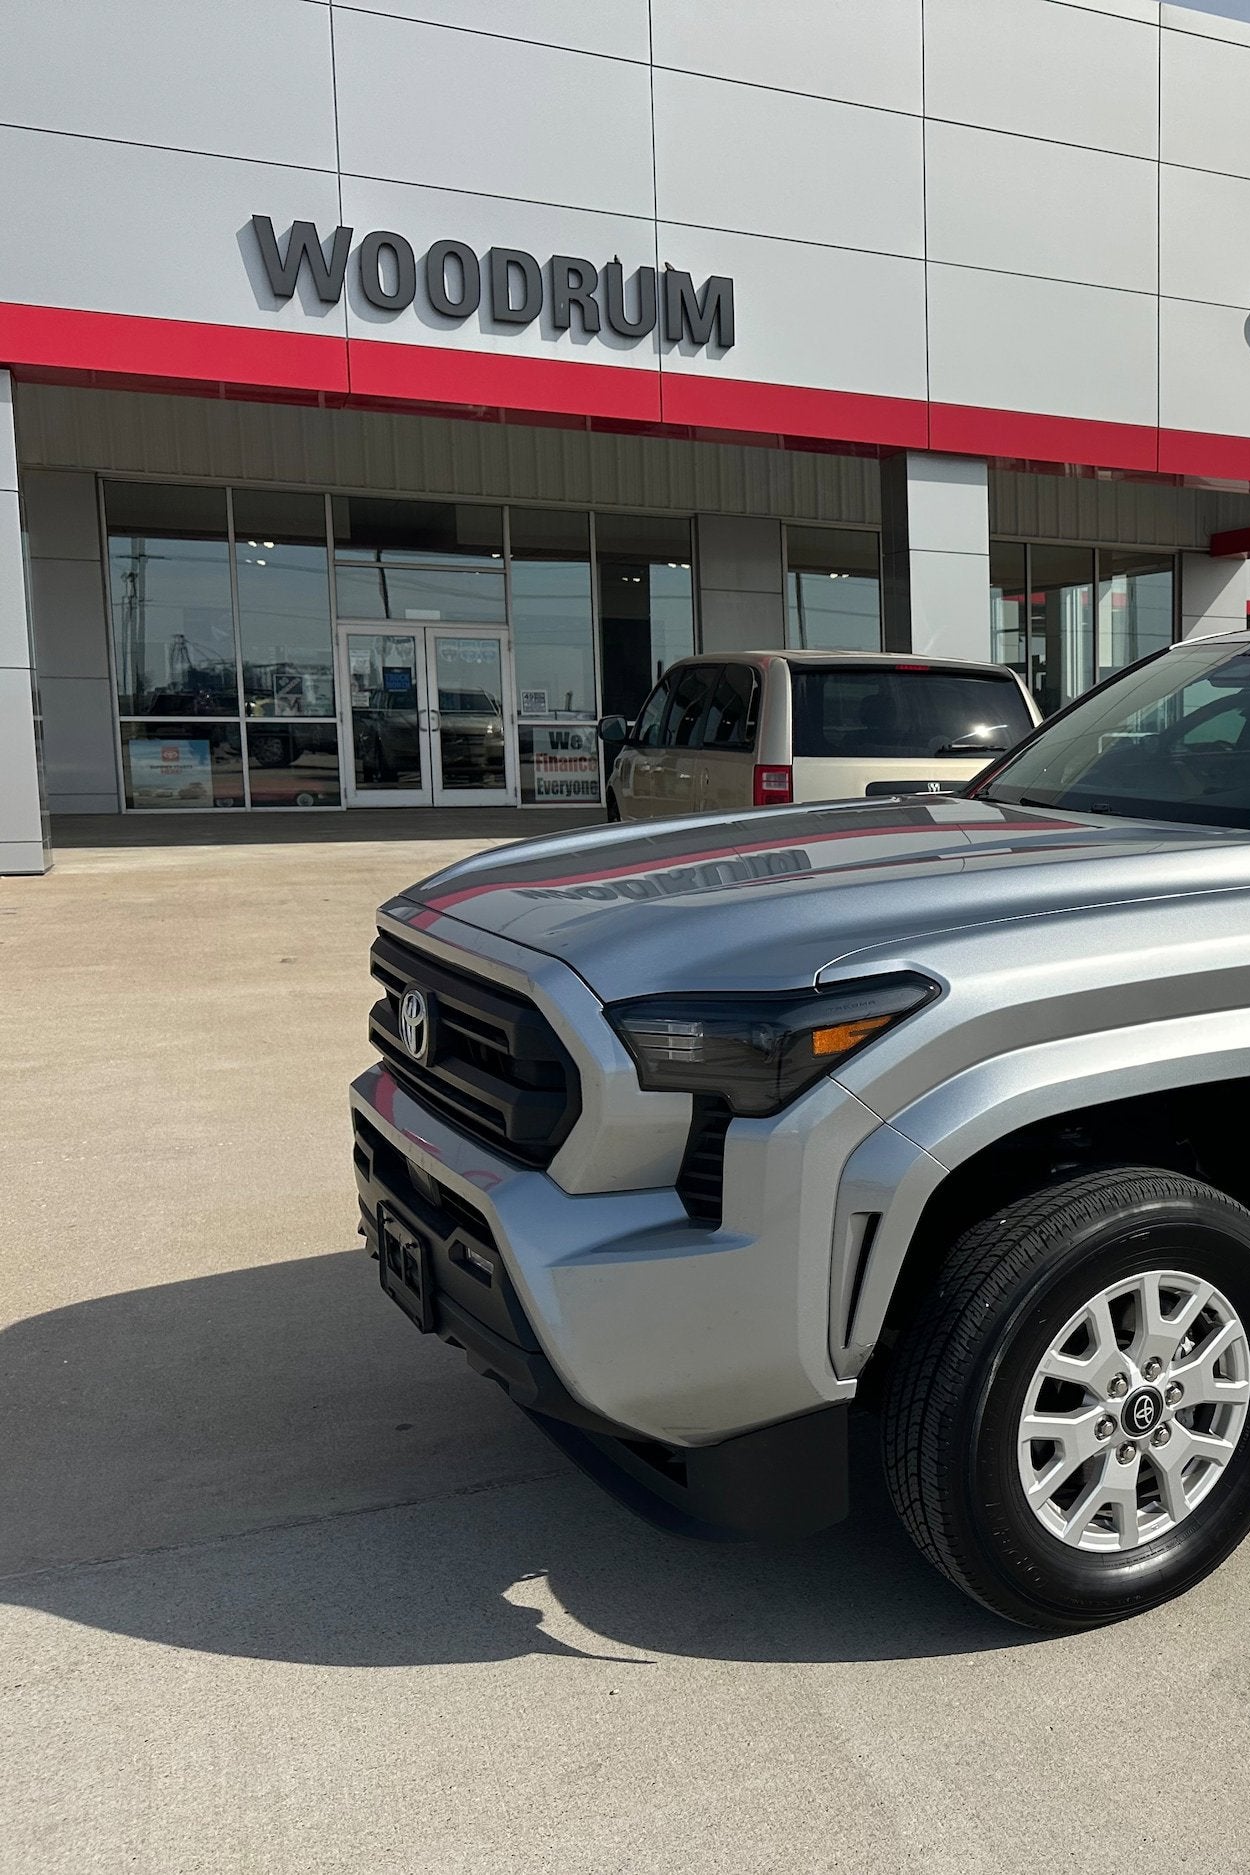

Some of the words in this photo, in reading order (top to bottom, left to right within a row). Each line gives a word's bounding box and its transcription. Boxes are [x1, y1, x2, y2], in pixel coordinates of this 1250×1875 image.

[252, 214, 734, 348] WOODRUM
[549, 731, 583, 750] We
[535, 753, 597, 772] Finance
[536, 778, 598, 797] Everyone
